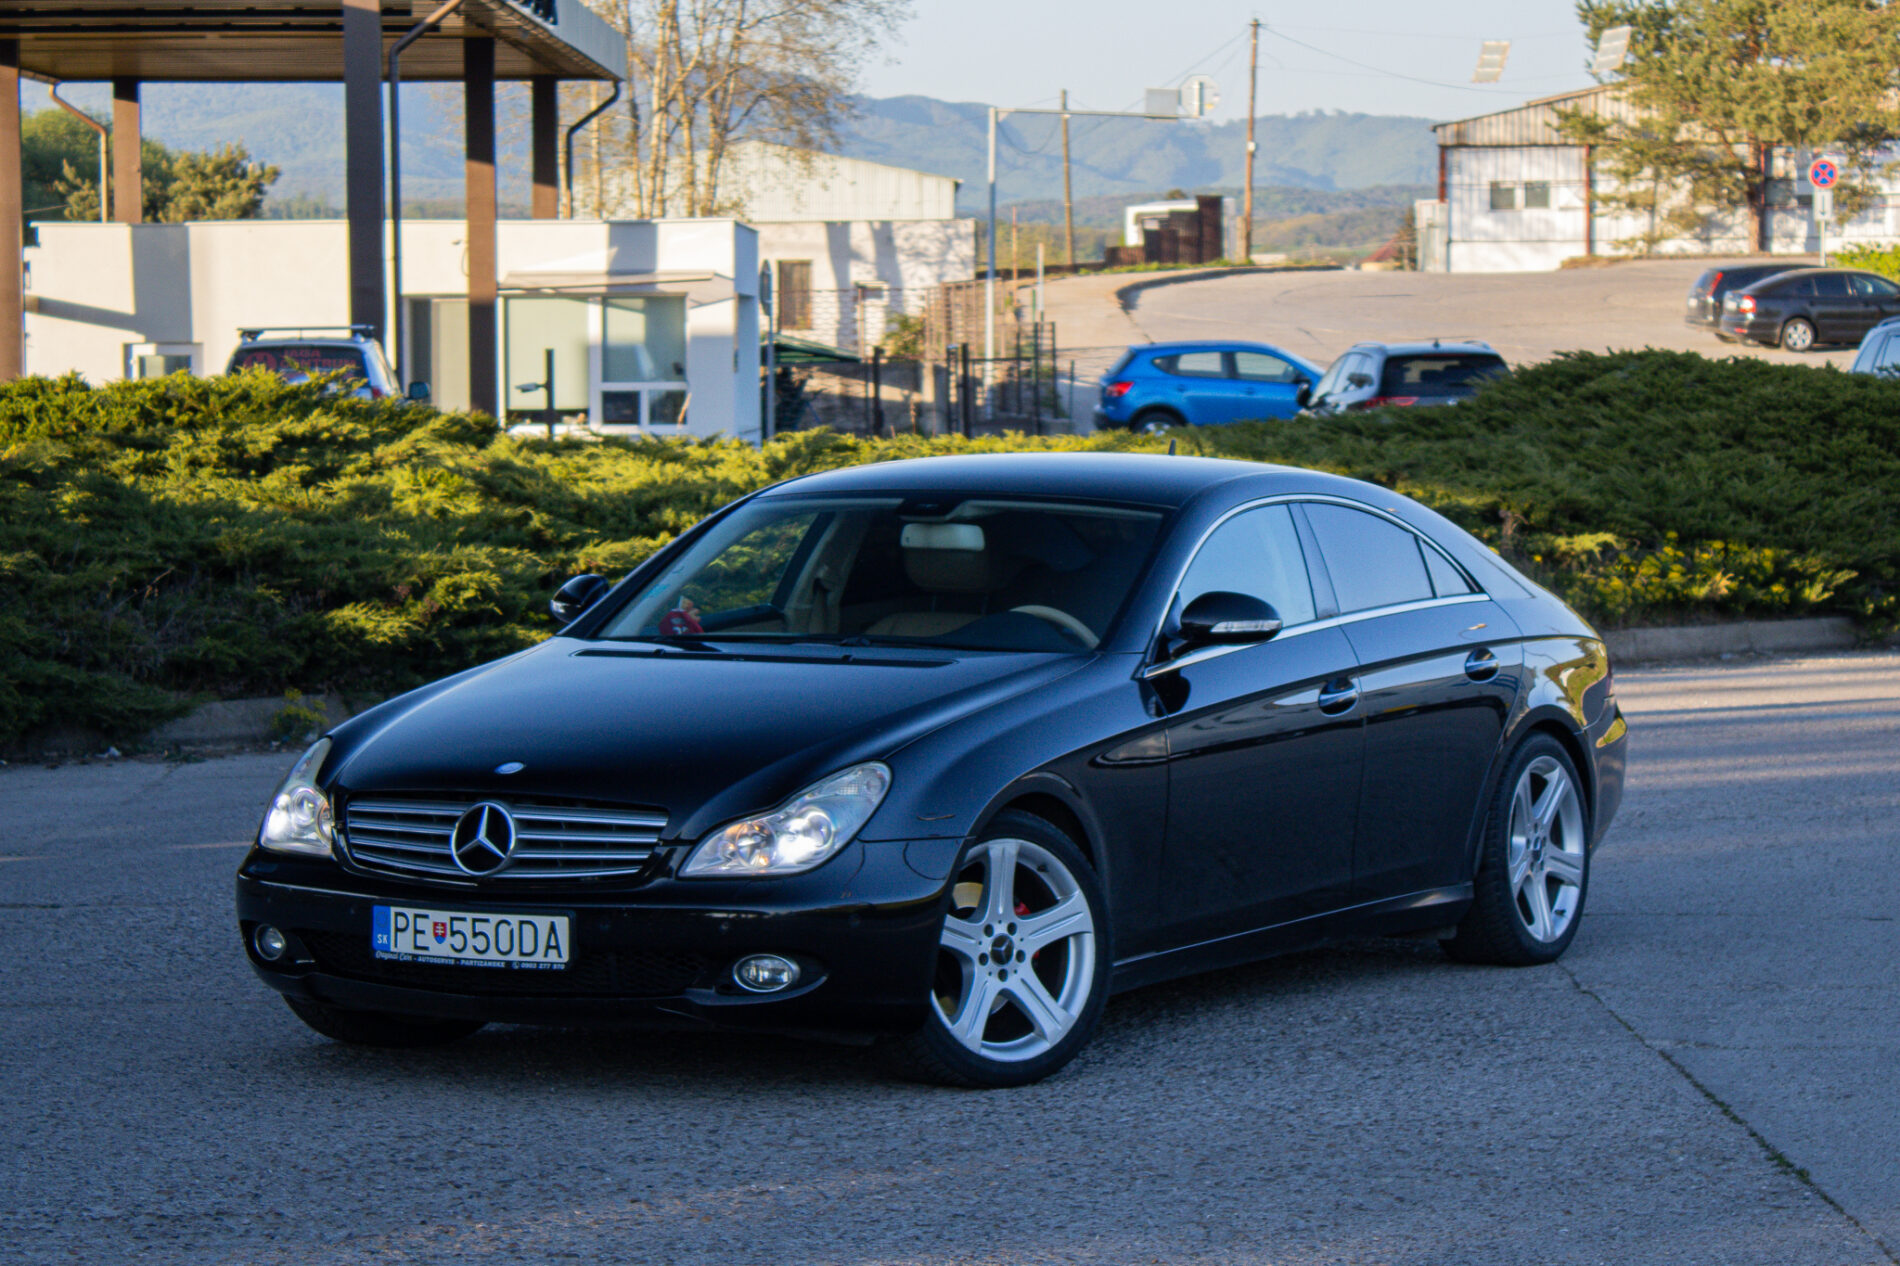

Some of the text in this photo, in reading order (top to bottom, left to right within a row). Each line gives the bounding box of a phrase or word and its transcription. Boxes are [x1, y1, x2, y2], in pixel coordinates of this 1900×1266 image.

[376, 933, 388, 945] SK
[394, 911, 563, 959] PE 550DA
